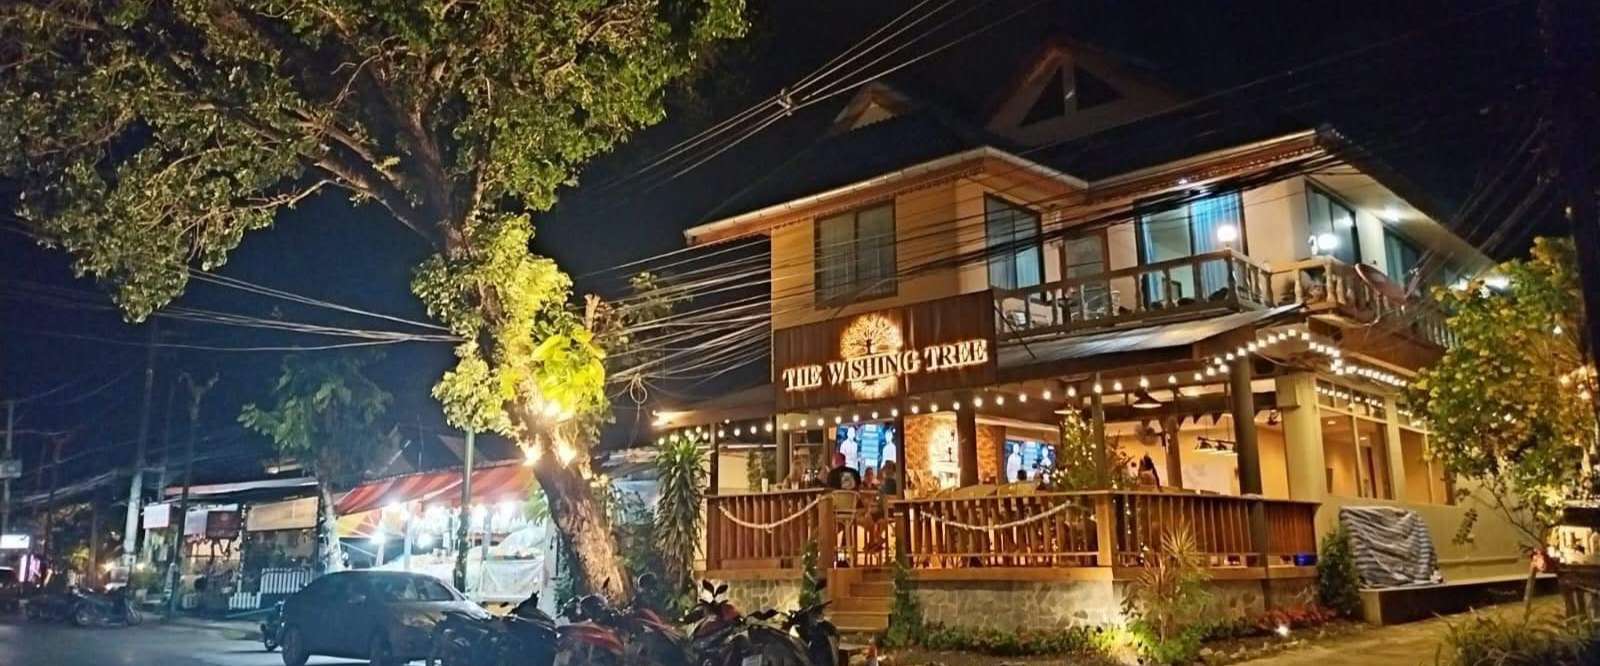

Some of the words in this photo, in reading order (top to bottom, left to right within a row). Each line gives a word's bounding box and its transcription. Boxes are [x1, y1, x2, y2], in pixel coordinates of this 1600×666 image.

[783, 365, 822, 391] THE
[827, 350, 921, 386] WISHING
[924, 338, 988, 372] TREE
